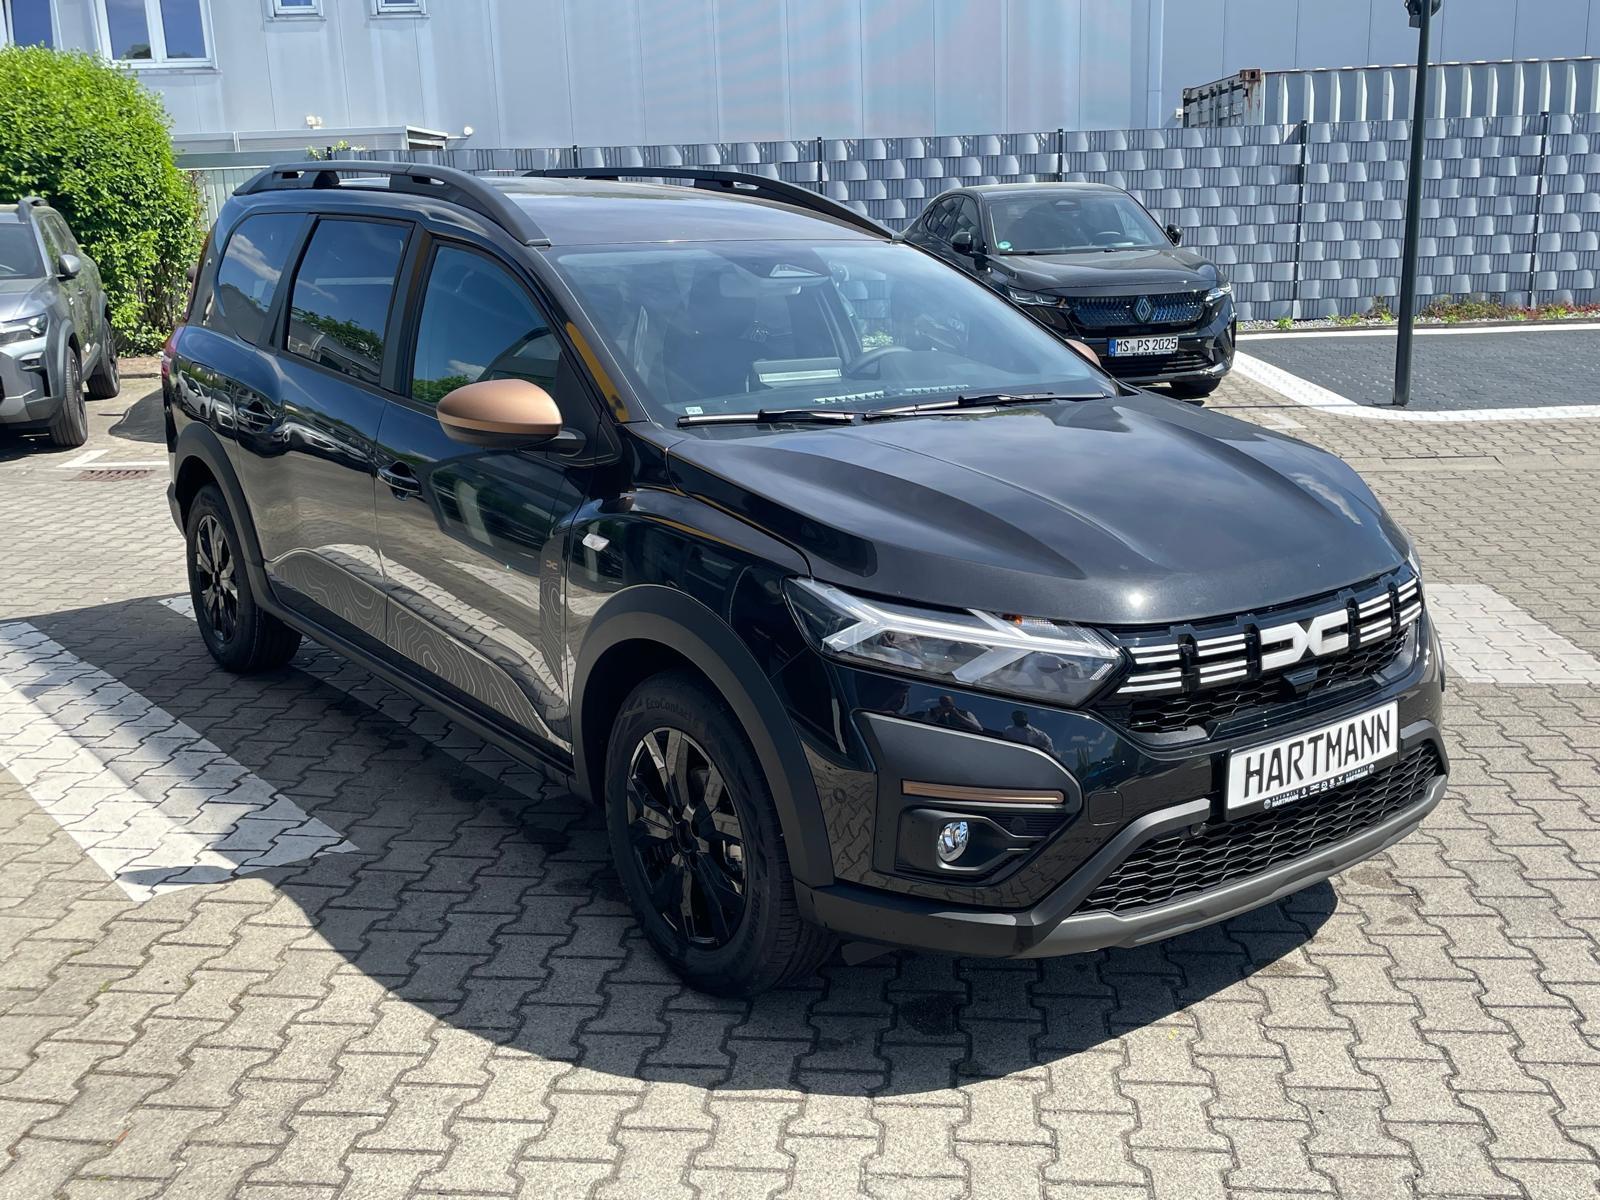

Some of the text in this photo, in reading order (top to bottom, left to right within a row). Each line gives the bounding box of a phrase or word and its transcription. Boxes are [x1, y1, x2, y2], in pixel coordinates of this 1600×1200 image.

[1116, 338, 1177, 353] MS PS 2025
[1244, 710, 1390, 798] HARTMANN
[1272, 794, 1300, 808] HARTMANN
